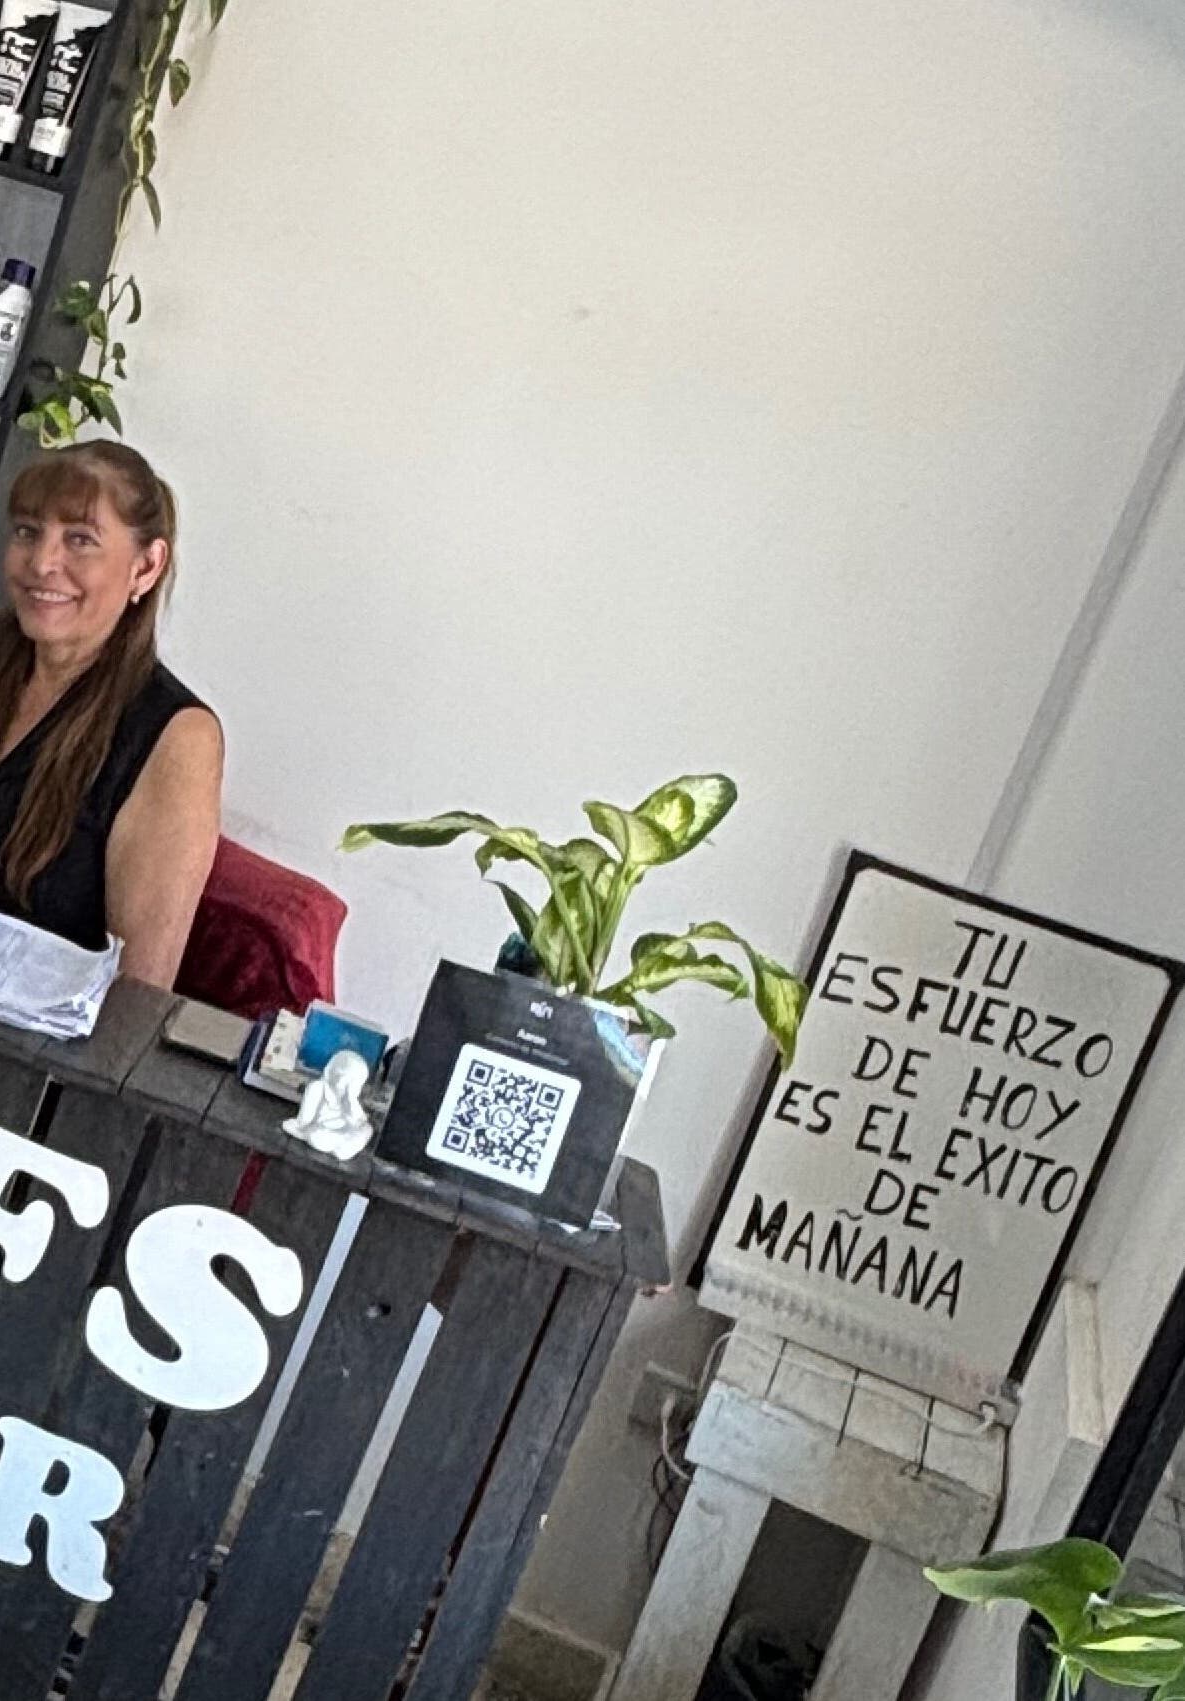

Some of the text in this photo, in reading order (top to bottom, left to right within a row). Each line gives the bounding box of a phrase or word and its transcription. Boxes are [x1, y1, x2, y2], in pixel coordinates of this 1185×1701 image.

[953, 919, 1029, 990] TU
[818, 951, 1115, 1079] ESFUERZO
[850, 1033, 1082, 1141] DE HOY
[773, 1079, 1079, 1215] ES EL EXITO
[862, 1167, 941, 1230] DE
[734, 1193, 965, 1321] MAÑANA
